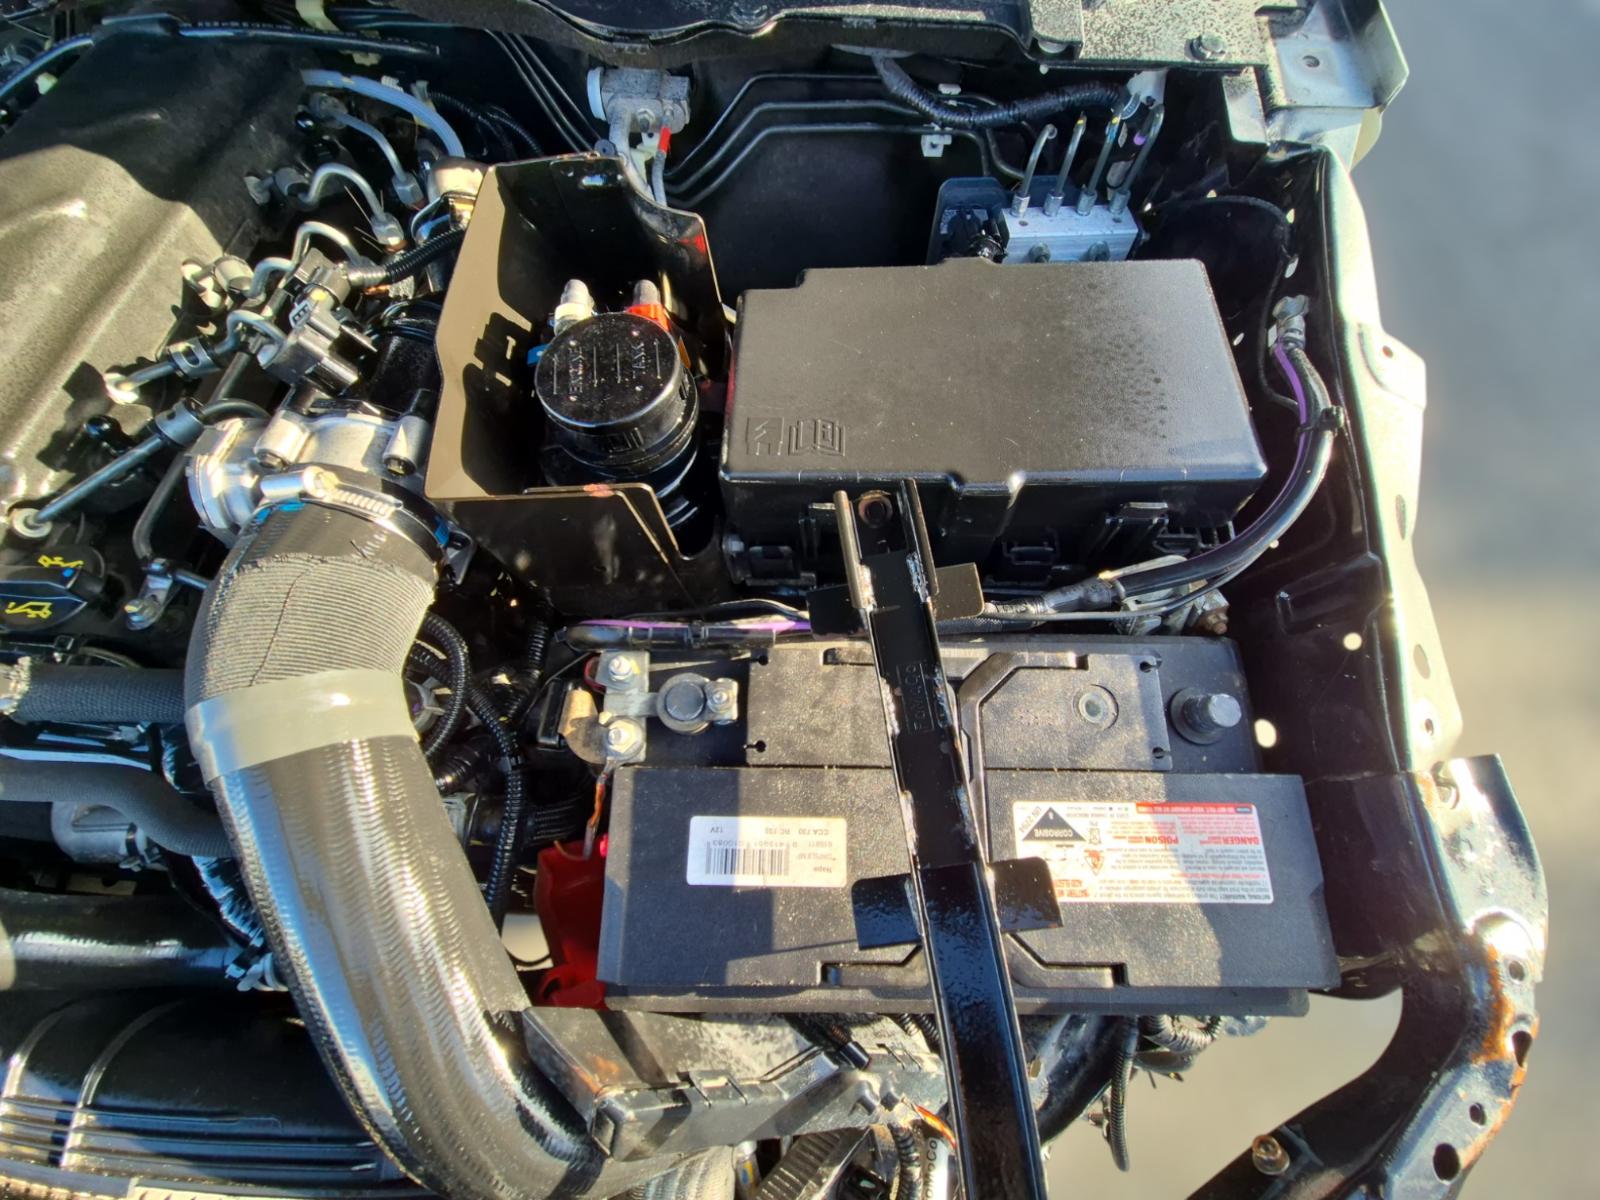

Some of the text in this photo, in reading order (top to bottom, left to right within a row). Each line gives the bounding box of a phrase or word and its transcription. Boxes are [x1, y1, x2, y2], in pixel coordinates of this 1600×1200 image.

[812, 828, 830, 836] CCA
[1034, 828, 1073, 838] CORROSIVE
[1145, 836, 1179, 845] POISON
[1223, 836, 1260, 845] DANGER
